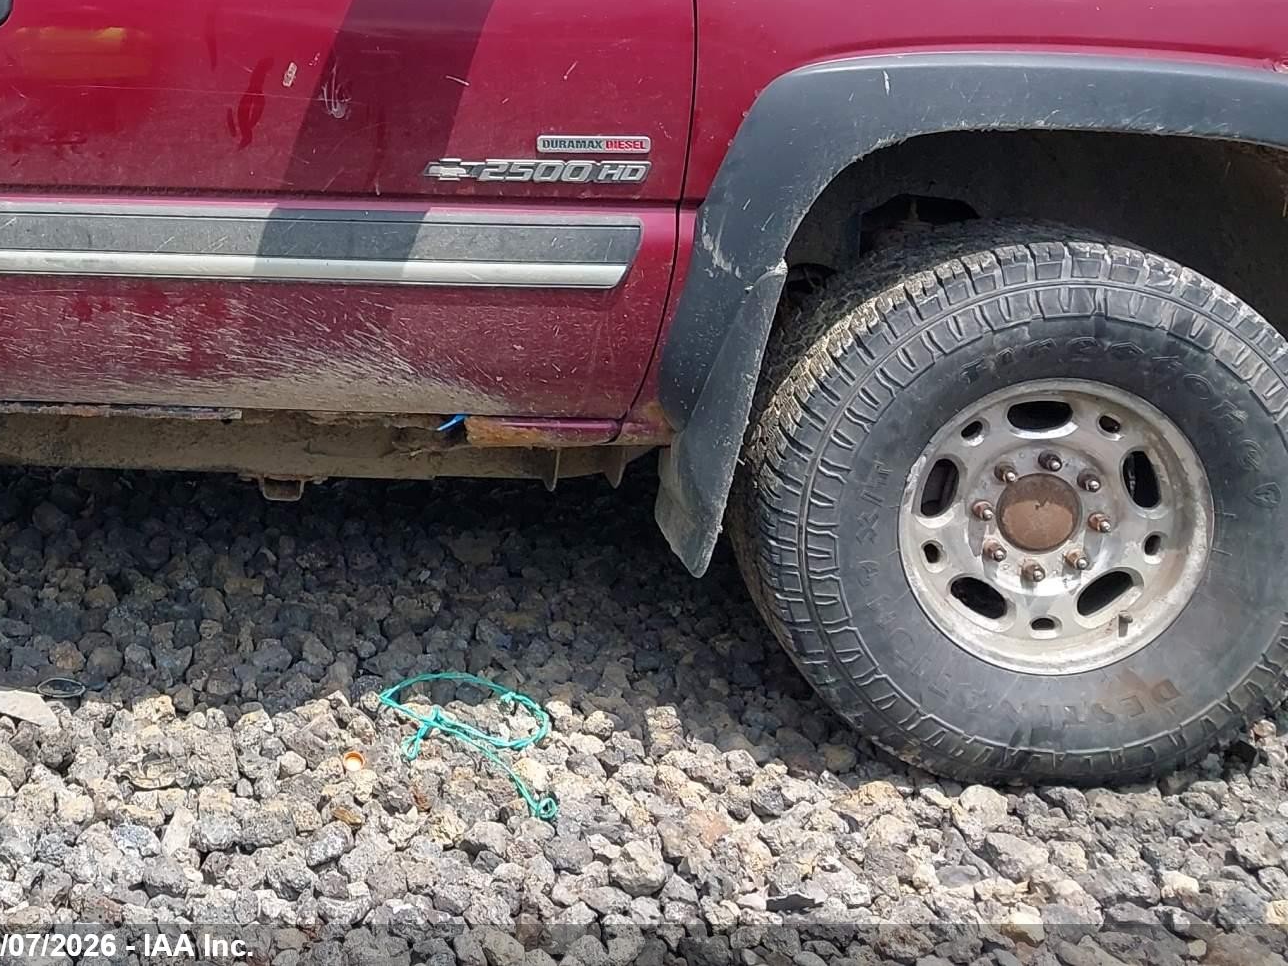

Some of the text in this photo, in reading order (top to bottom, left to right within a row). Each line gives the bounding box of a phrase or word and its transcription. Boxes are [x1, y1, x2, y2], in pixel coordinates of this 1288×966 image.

[542, 139, 645, 150] DURAMAX DIESEL
[478, 160, 650, 182] 2500 HD
